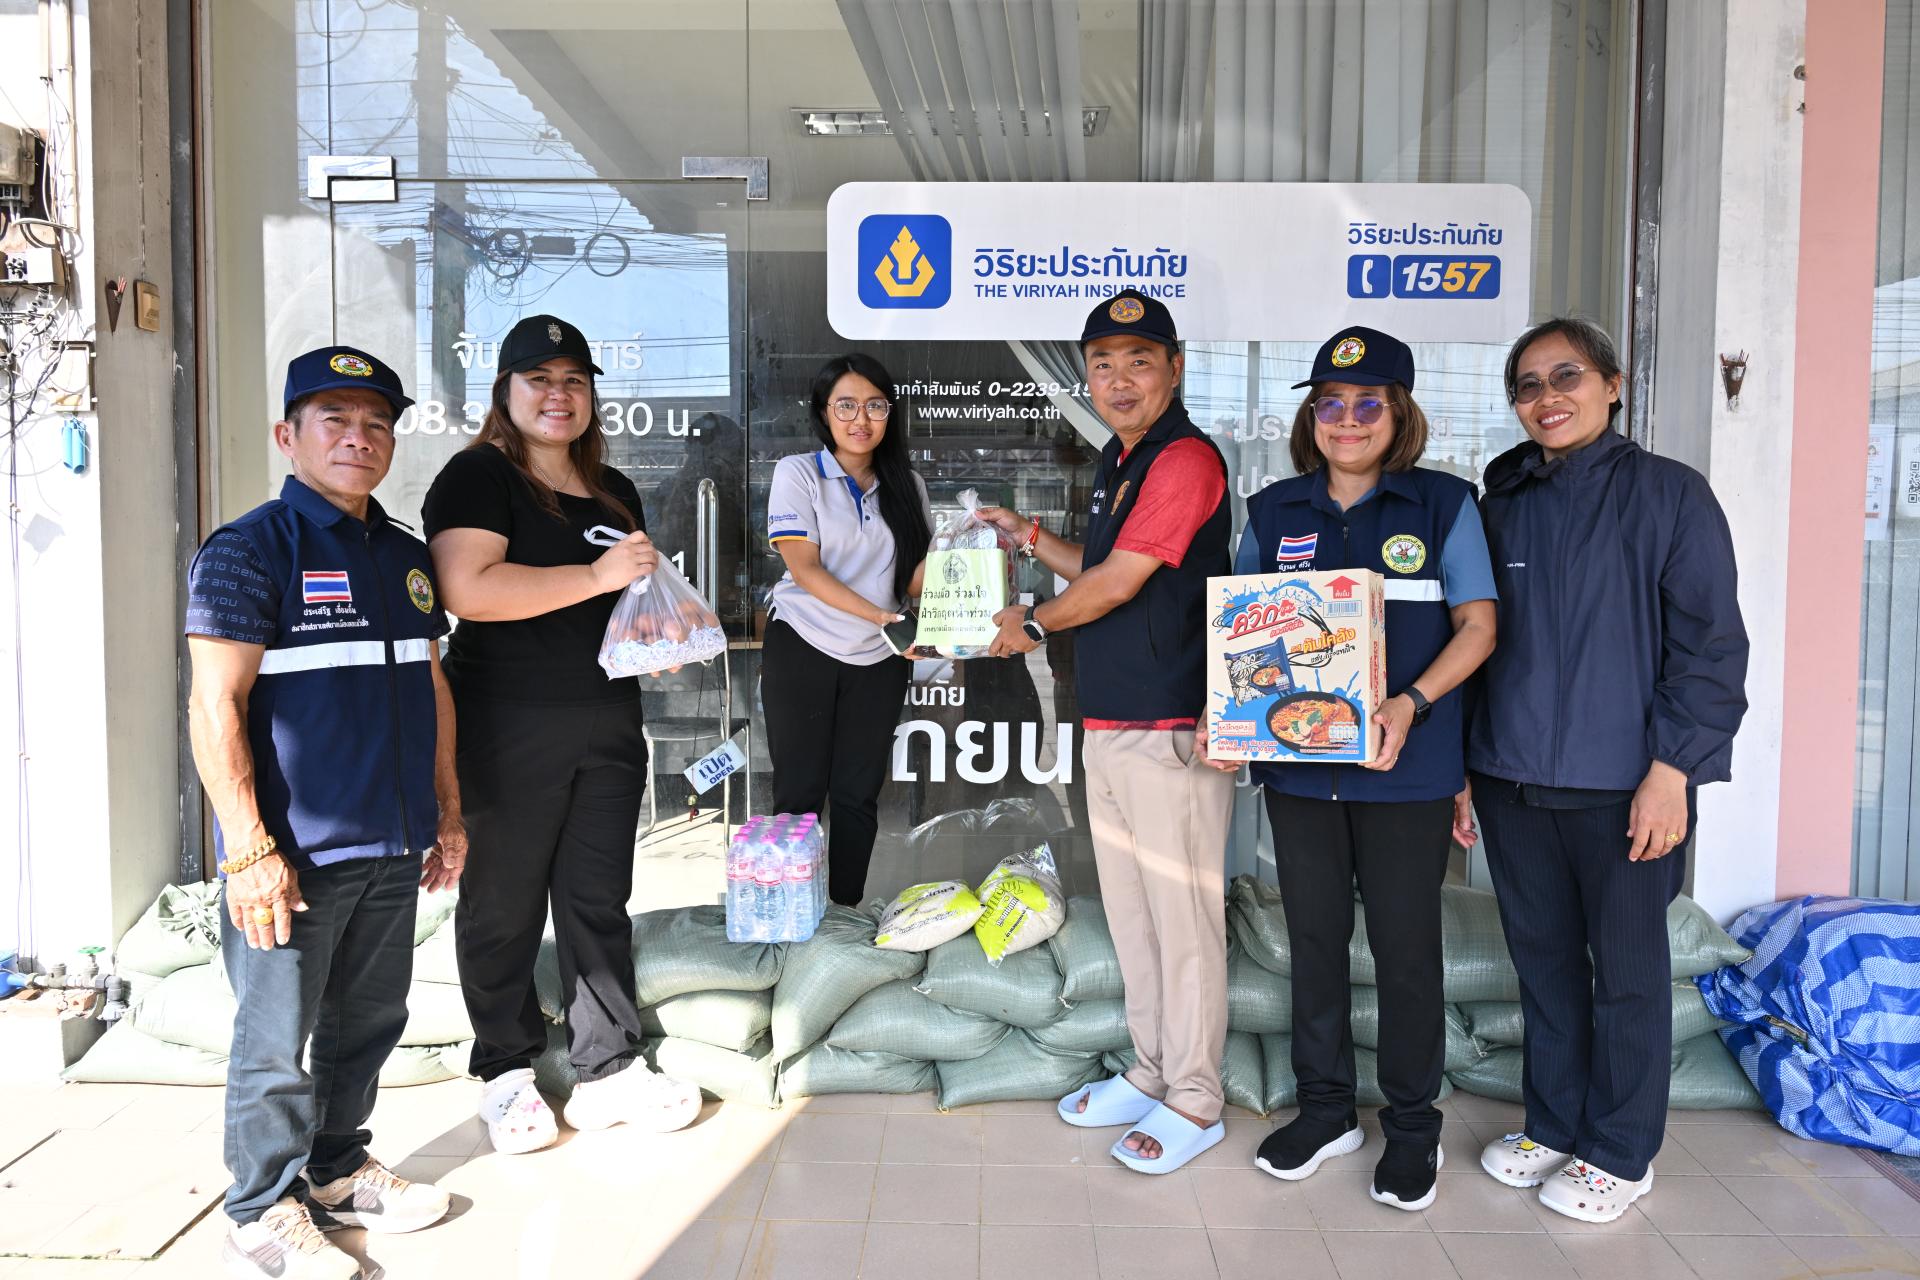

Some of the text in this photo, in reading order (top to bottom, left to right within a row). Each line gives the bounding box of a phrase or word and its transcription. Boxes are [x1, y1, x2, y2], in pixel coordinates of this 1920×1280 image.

[1347, 222, 1503, 246] วิริยะประกันภัย
[973, 245, 1188, 278] วิริยะประกันภัย
[1402, 262, 1492, 293] 1557
[974, 284, 1007, 298] THE
[1012, 284, 1080, 298] VIRIYAH
[917, 405, 1060, 422] www.viriyah.co.th
[709, 764, 735, 785] OPEN
